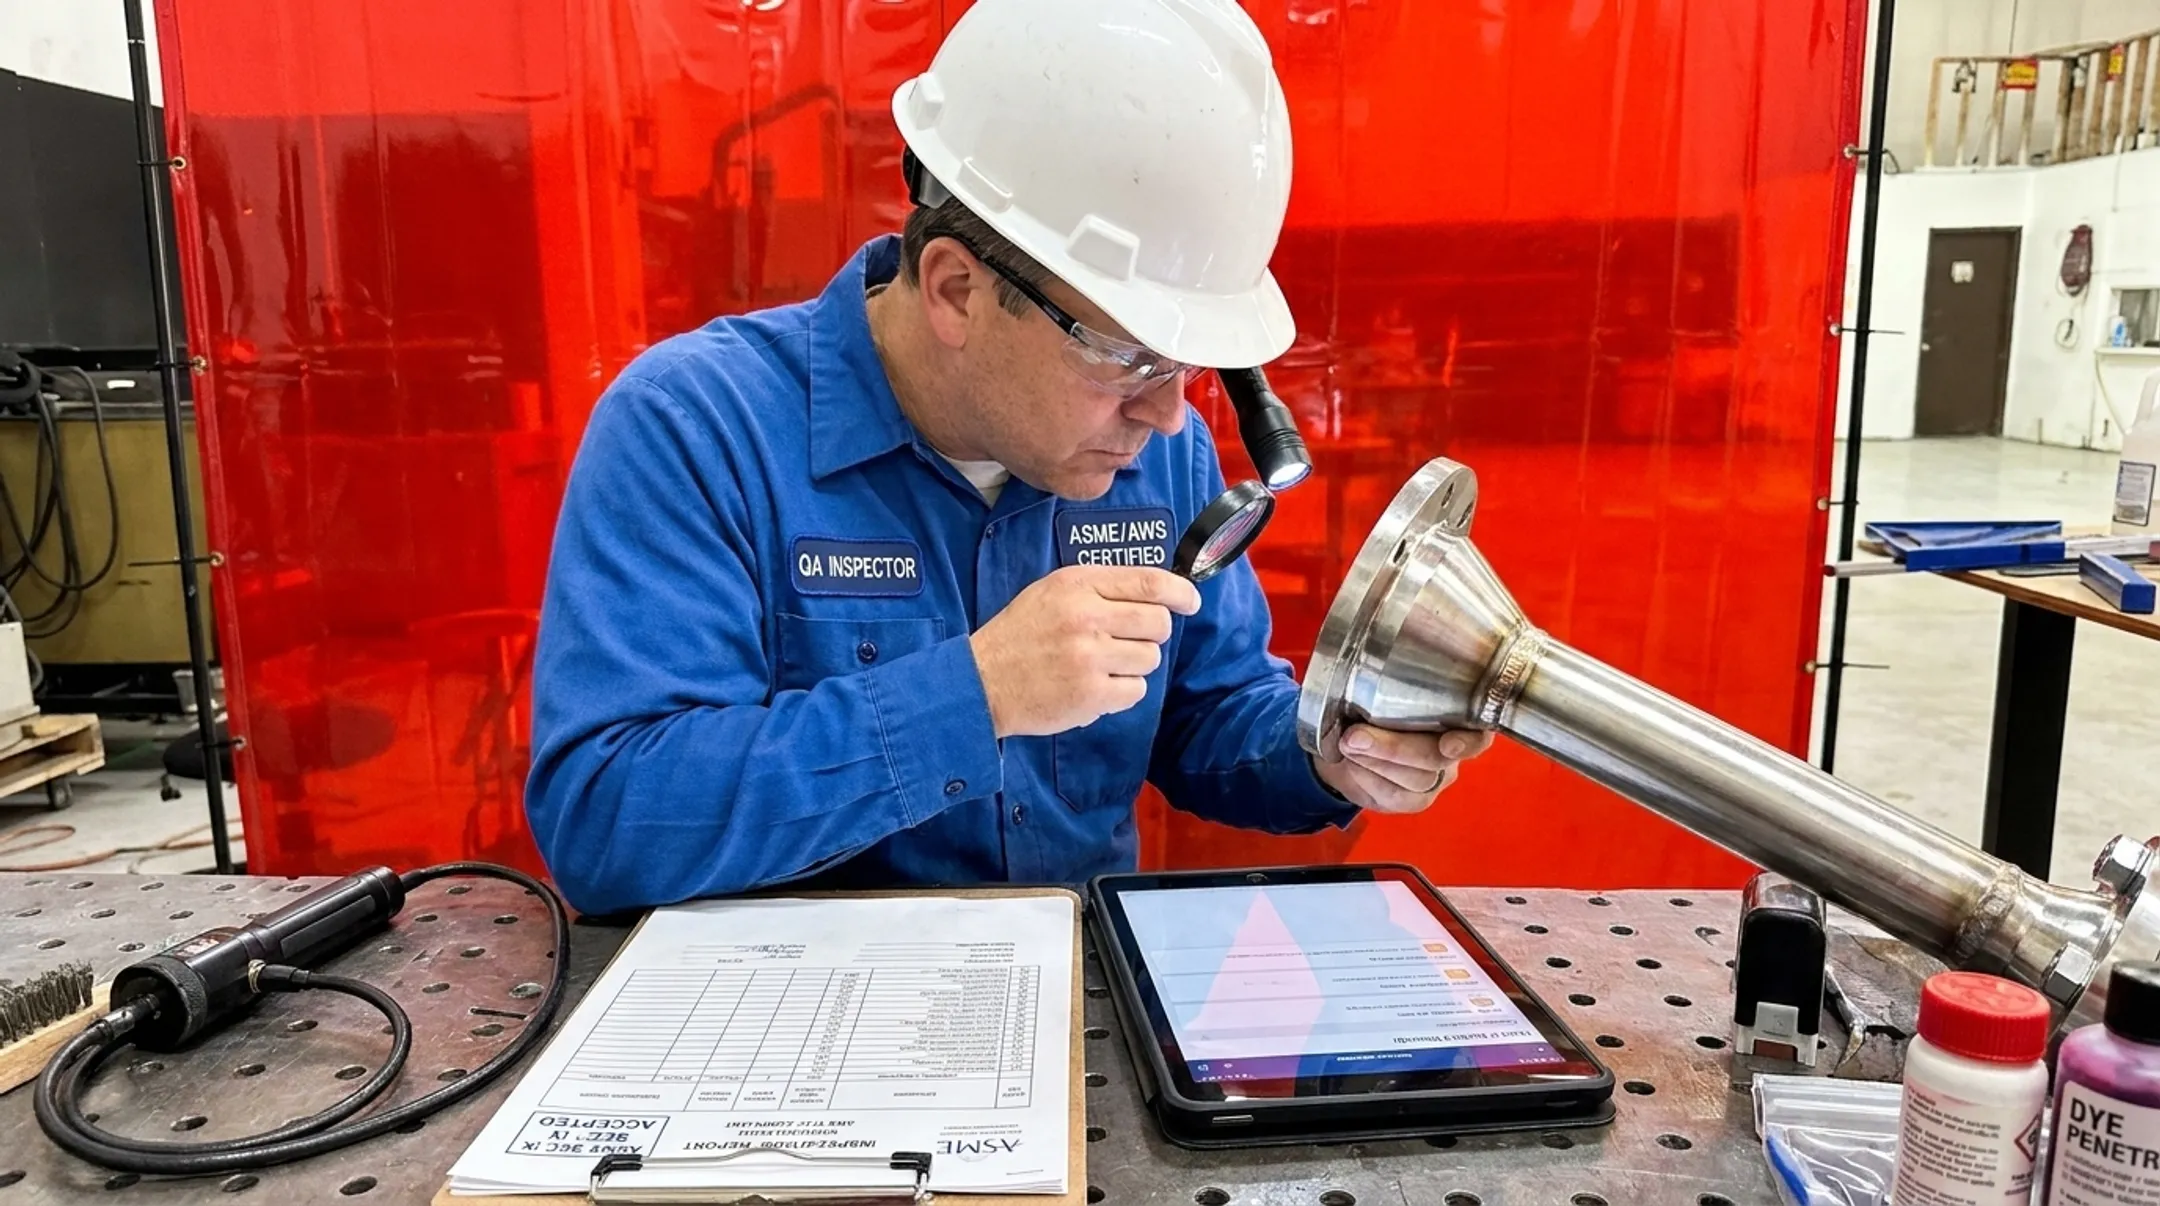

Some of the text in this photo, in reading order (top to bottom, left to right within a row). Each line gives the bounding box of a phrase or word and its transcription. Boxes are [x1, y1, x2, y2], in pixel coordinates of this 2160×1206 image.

[1069, 519, 1167, 545] ASME/AWS
[798, 552, 917, 579] QA INSPECTOR
[2070, 1096, 2125, 1138] DYE
[937, 1138, 1022, 1155] ASME
[2065, 1123, 2160, 1171] PENETR
